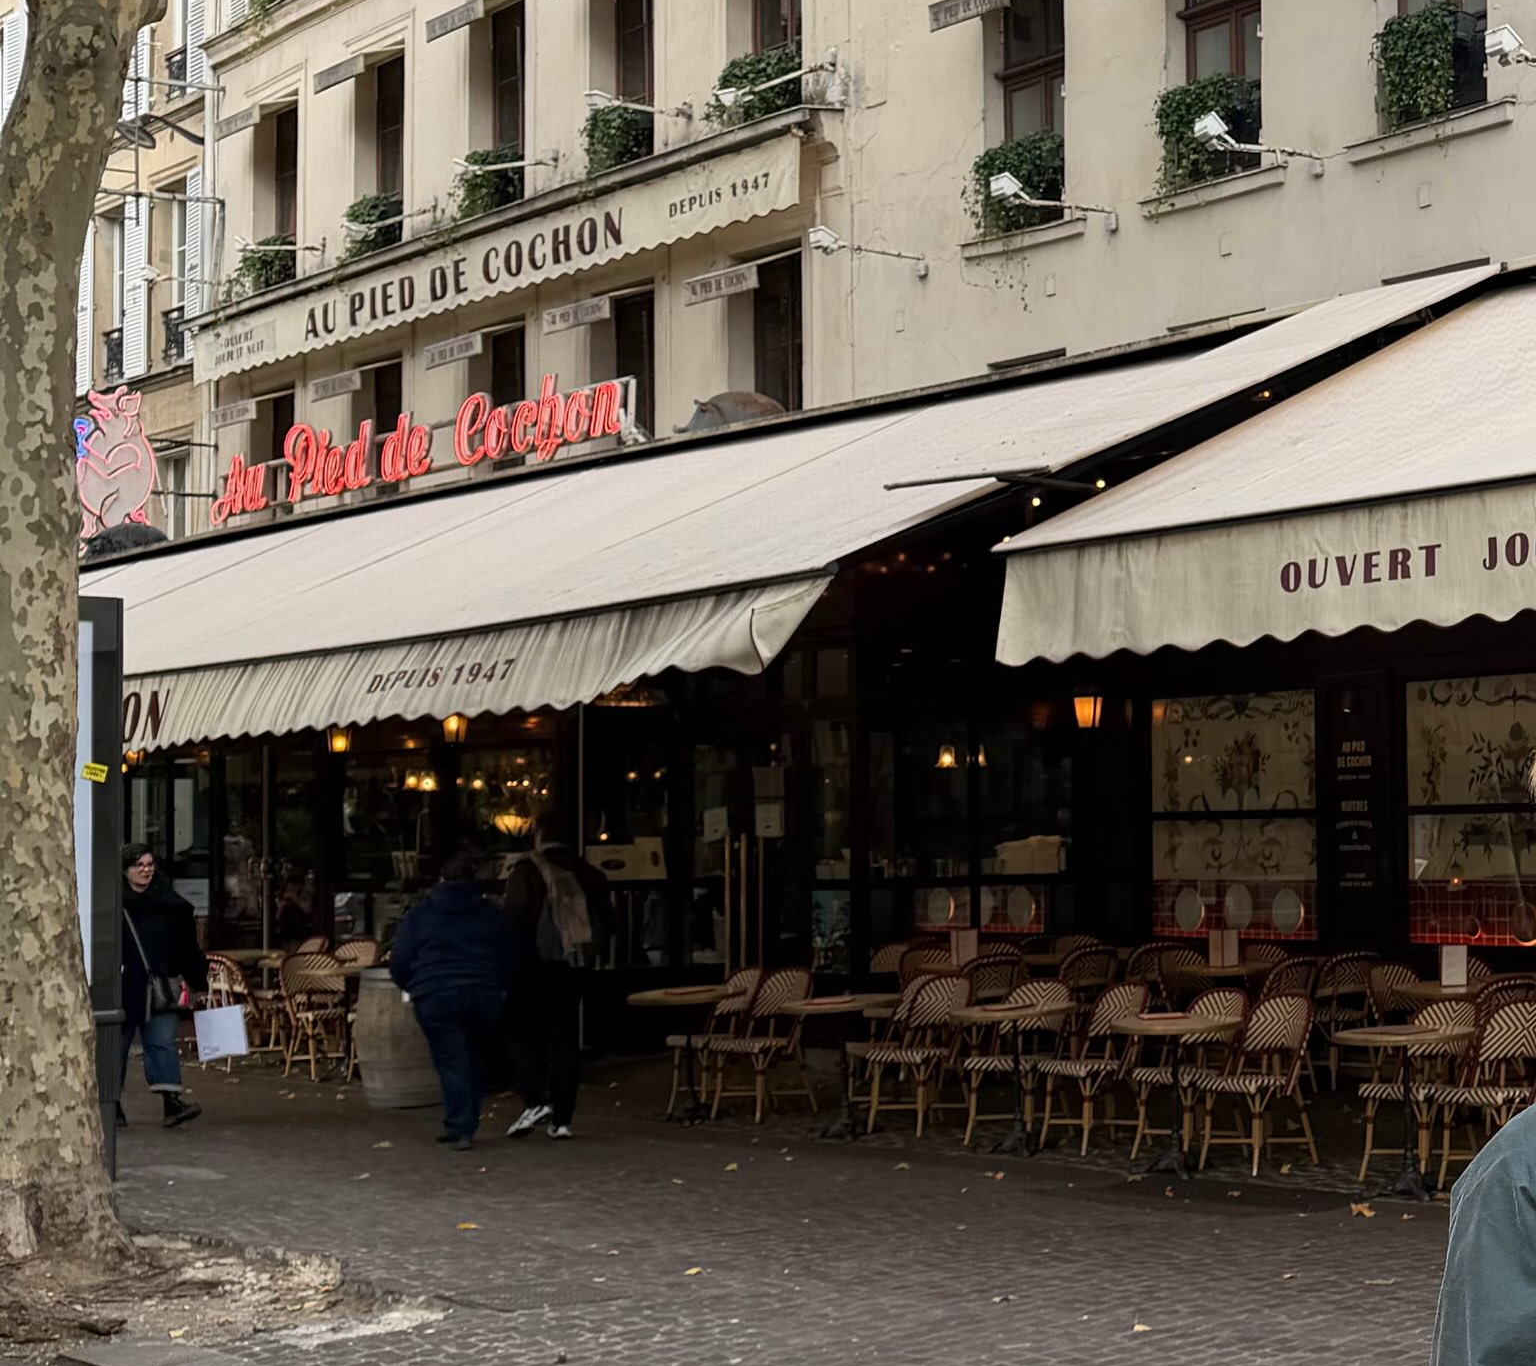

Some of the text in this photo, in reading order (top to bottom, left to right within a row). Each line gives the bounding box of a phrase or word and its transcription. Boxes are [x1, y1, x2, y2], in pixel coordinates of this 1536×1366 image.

[668, 172, 771, 219] DEPUIS 1947
[304, 207, 625, 341] AU PIED DE COCHON
[210, 372, 622, 525] Au Pied de Cochon
[1280, 543, 1442, 593] OUVERT
[366, 658, 516, 695] DEPUIS 1947
[123, 688, 170, 744] ON
